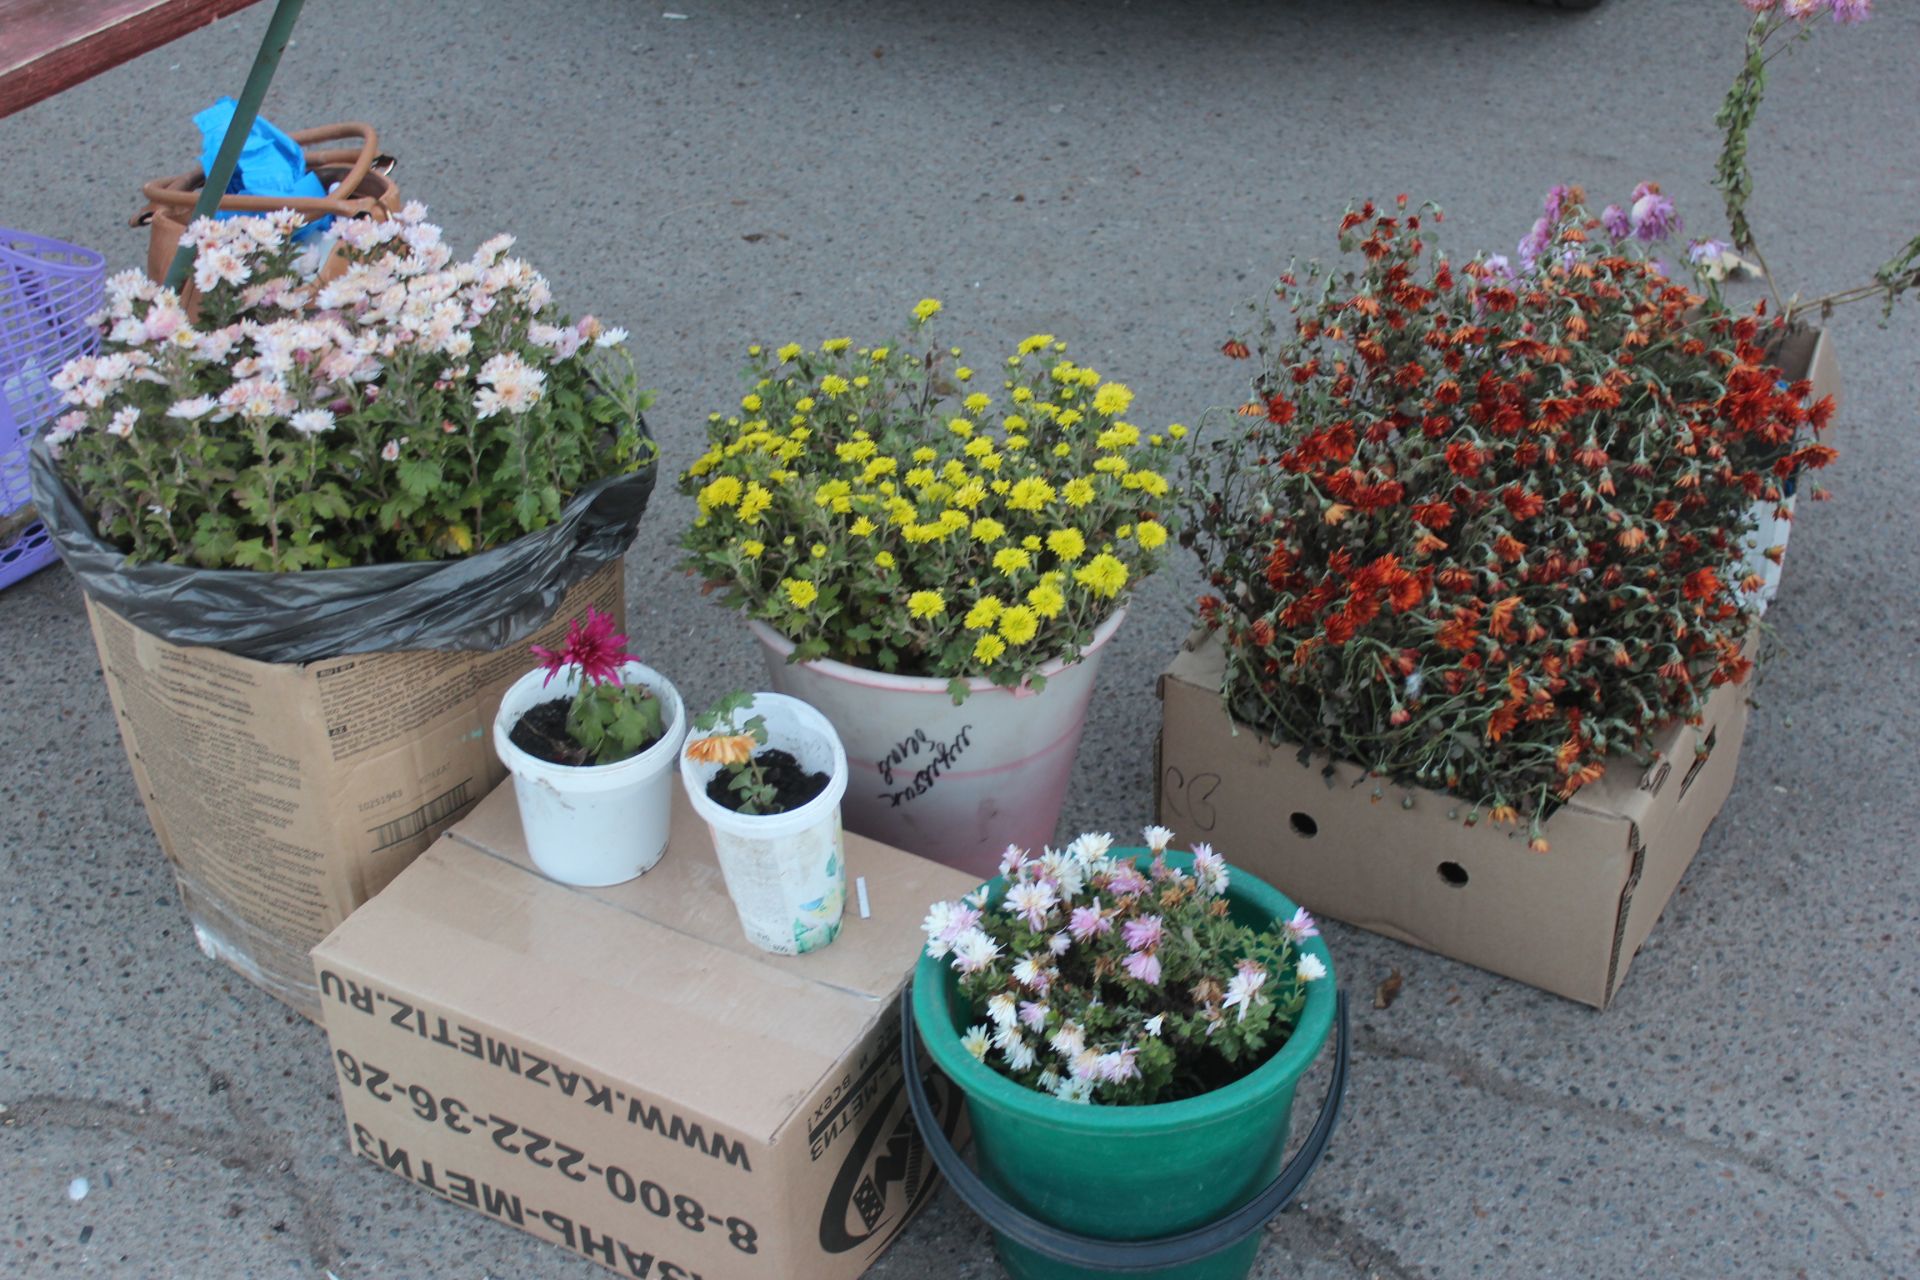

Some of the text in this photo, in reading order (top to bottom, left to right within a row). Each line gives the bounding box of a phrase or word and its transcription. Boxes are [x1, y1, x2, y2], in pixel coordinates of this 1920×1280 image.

[320, 970, 752, 1172] WWW.KAZMETIZ.RU
[336, 1048, 758, 1254] 8-800-222-36-26
[353, 1122, 703, 1280] ЗАНЬ-МЕТИЗ
